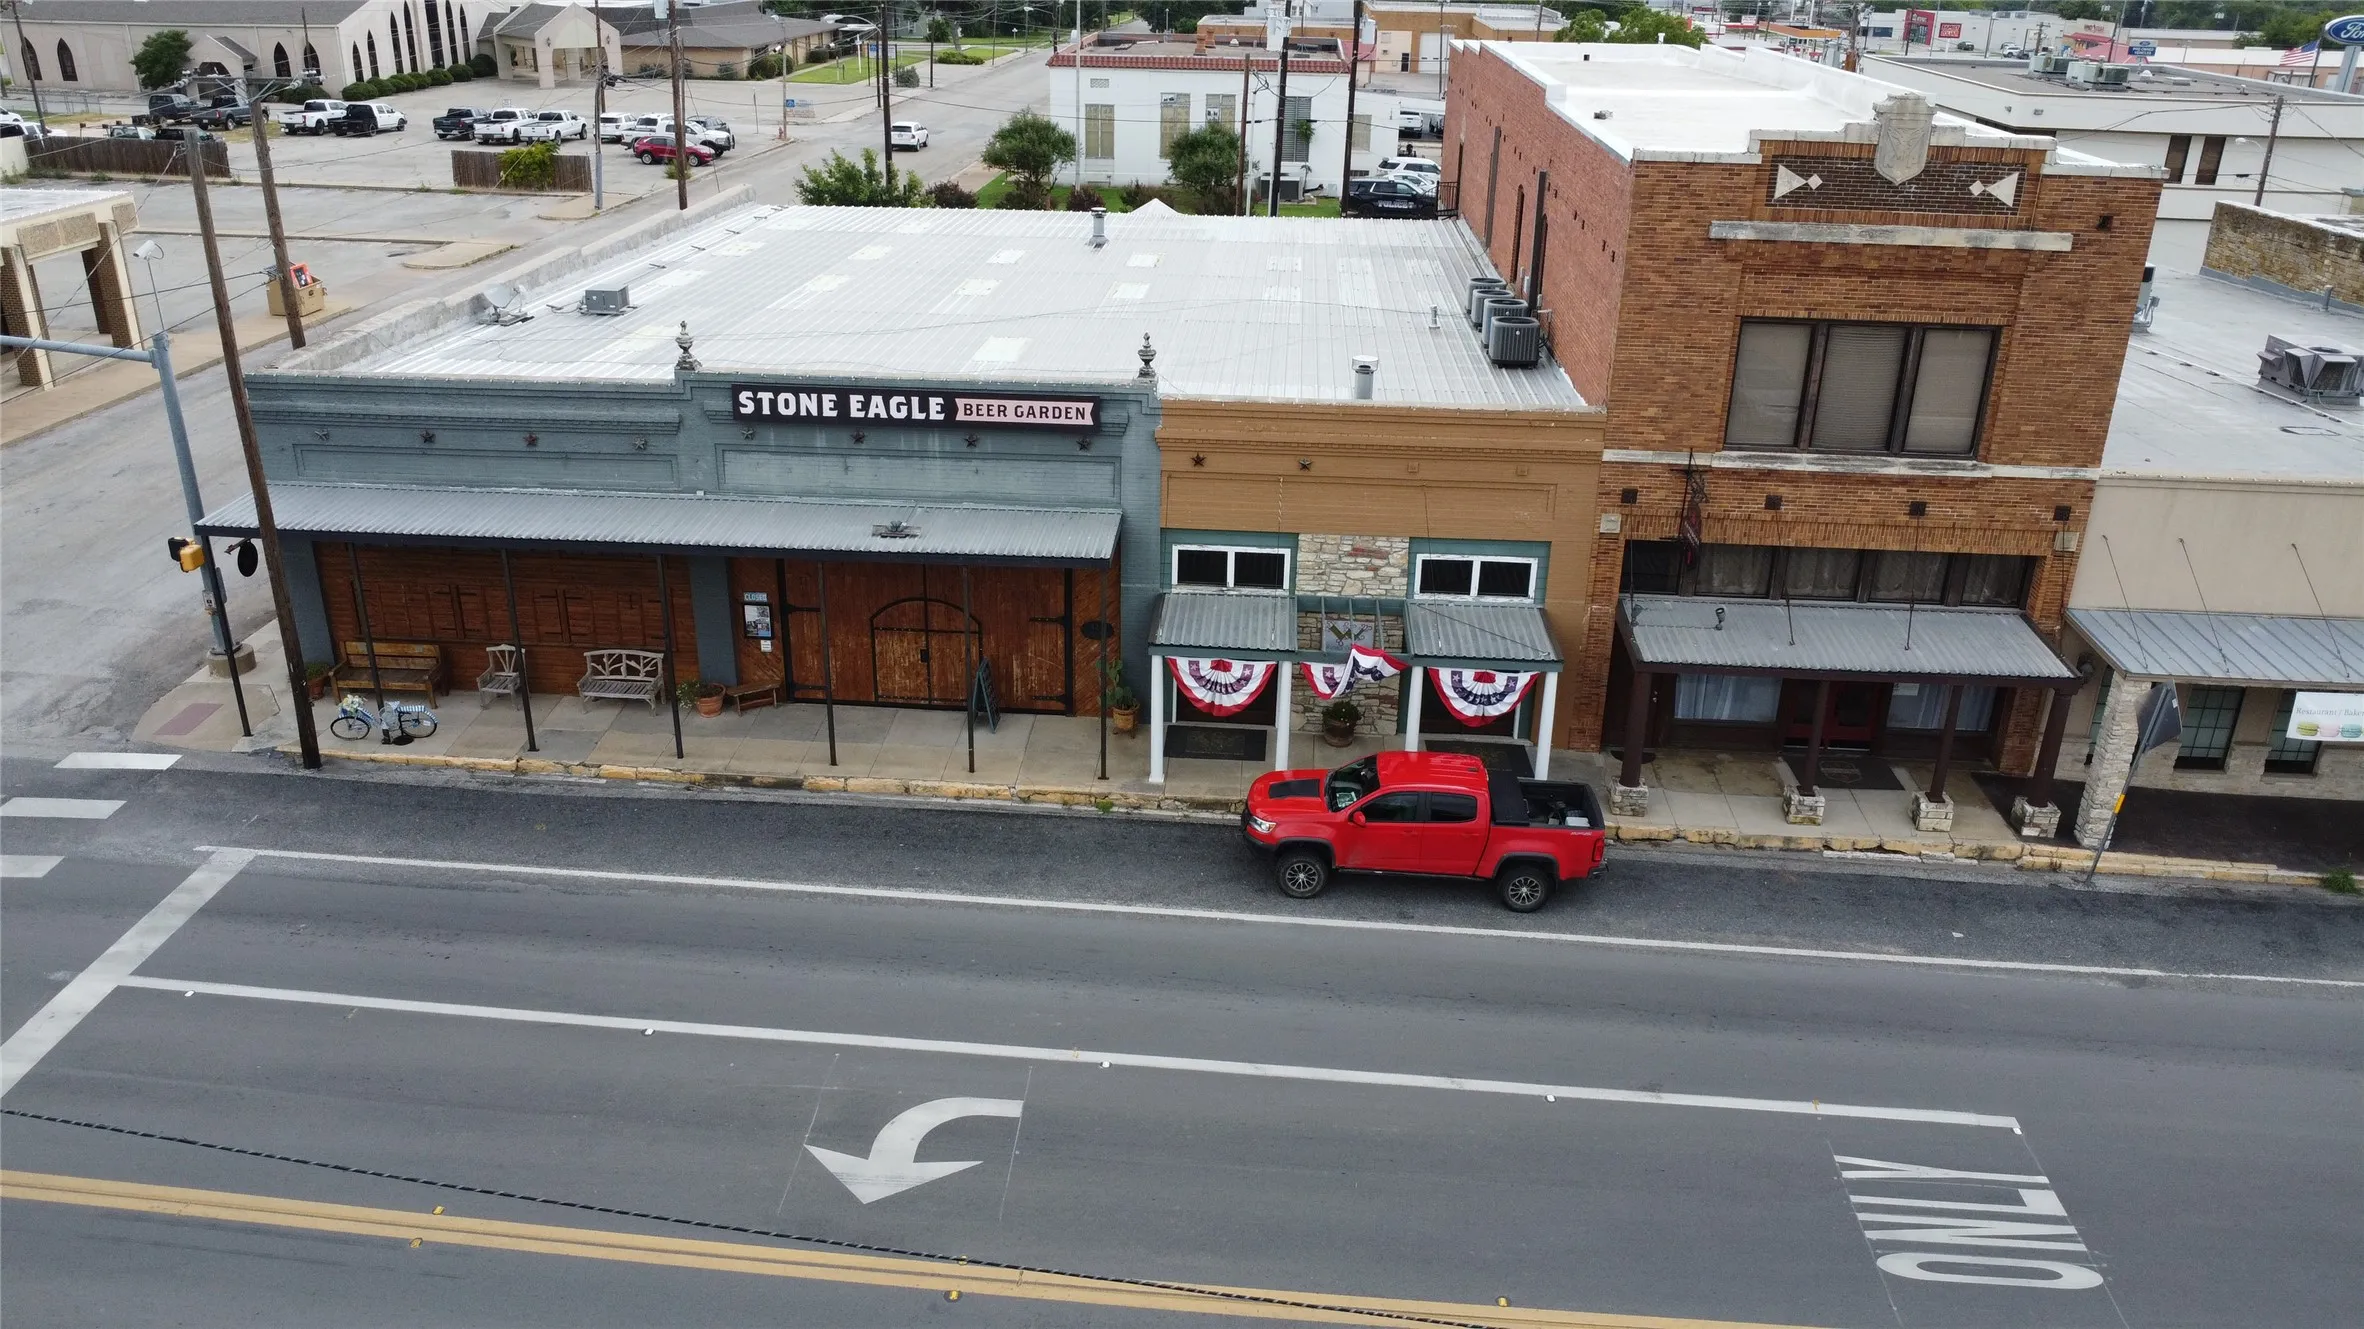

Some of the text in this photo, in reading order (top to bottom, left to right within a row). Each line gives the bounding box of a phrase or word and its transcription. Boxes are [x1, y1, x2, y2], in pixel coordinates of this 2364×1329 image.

[2341, 22, 2364, 39] For
[1378, 200, 1408, 209] POLICE
[738, 391, 1086, 421] STONE EAGLE BEER GARDEN
[744, 593, 767, 601] CLOSED
[2296, 708, 2337, 716] Restaurant
[2344, 709, 2364, 717] Baker
[1834, 1155, 2104, 1290] ONLY
